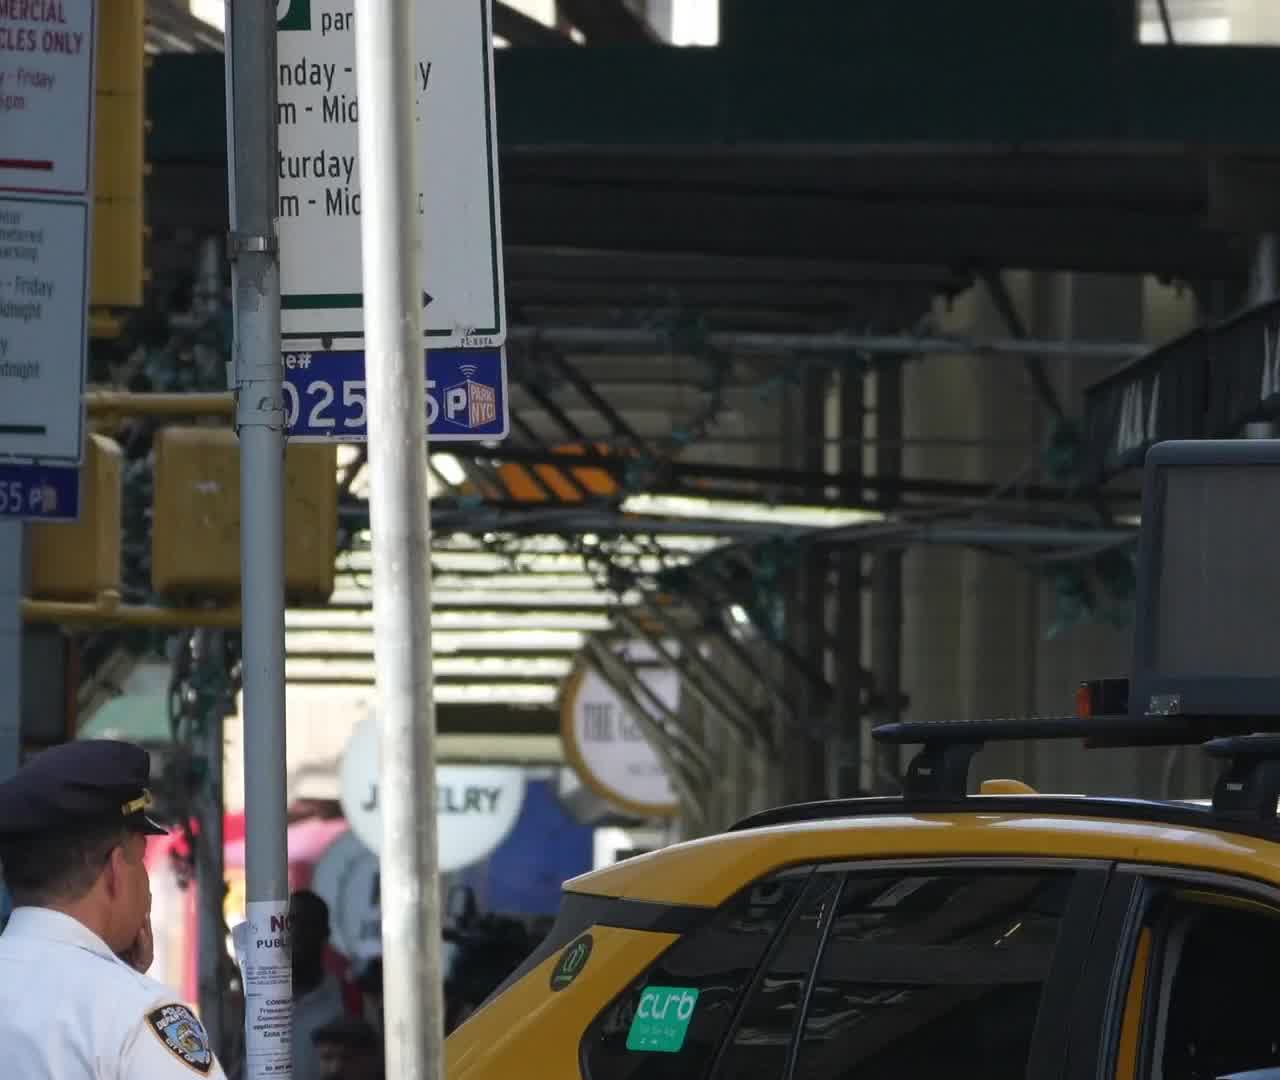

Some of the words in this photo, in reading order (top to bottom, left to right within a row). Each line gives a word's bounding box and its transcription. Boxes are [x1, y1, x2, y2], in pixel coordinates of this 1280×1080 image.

[322, 12, 354, 36] par
[42, 30, 83, 54] ONLY
[280, 56, 335, 91] nday
[279, 149, 354, 184] turday
[15, 275, 54, 299] Friday
[638, 991, 695, 1020] curb
